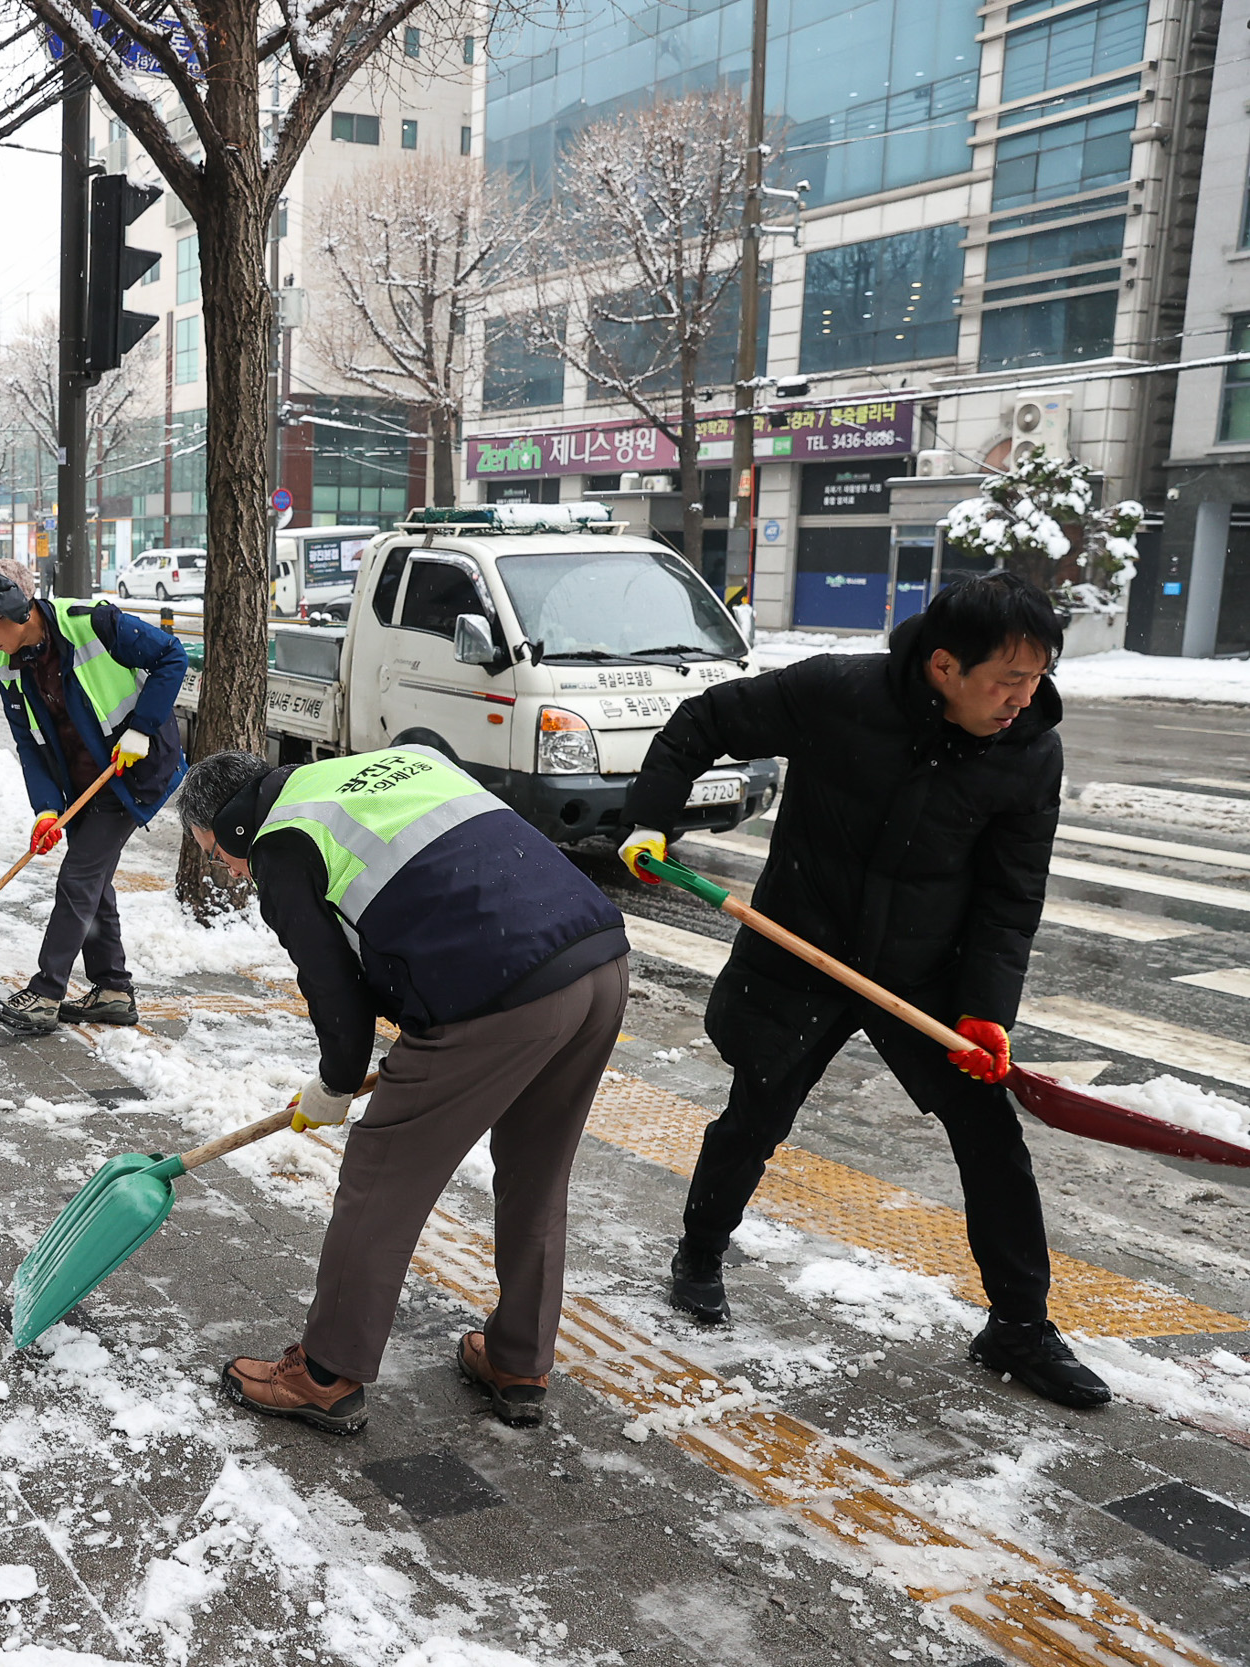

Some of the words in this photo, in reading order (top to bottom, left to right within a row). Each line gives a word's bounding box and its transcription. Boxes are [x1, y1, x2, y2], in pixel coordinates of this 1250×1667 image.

[549, 427, 657, 466] 제니스병원
[806, 434, 829, 451] TEL.
[476, 437, 542, 473] Zenith
[598, 671, 653, 689] 욕실리모델링
[624, 695, 673, 718] 욕실미학
[334, 756, 406, 794] 광진구
[702, 783, 734, 802] 2720
